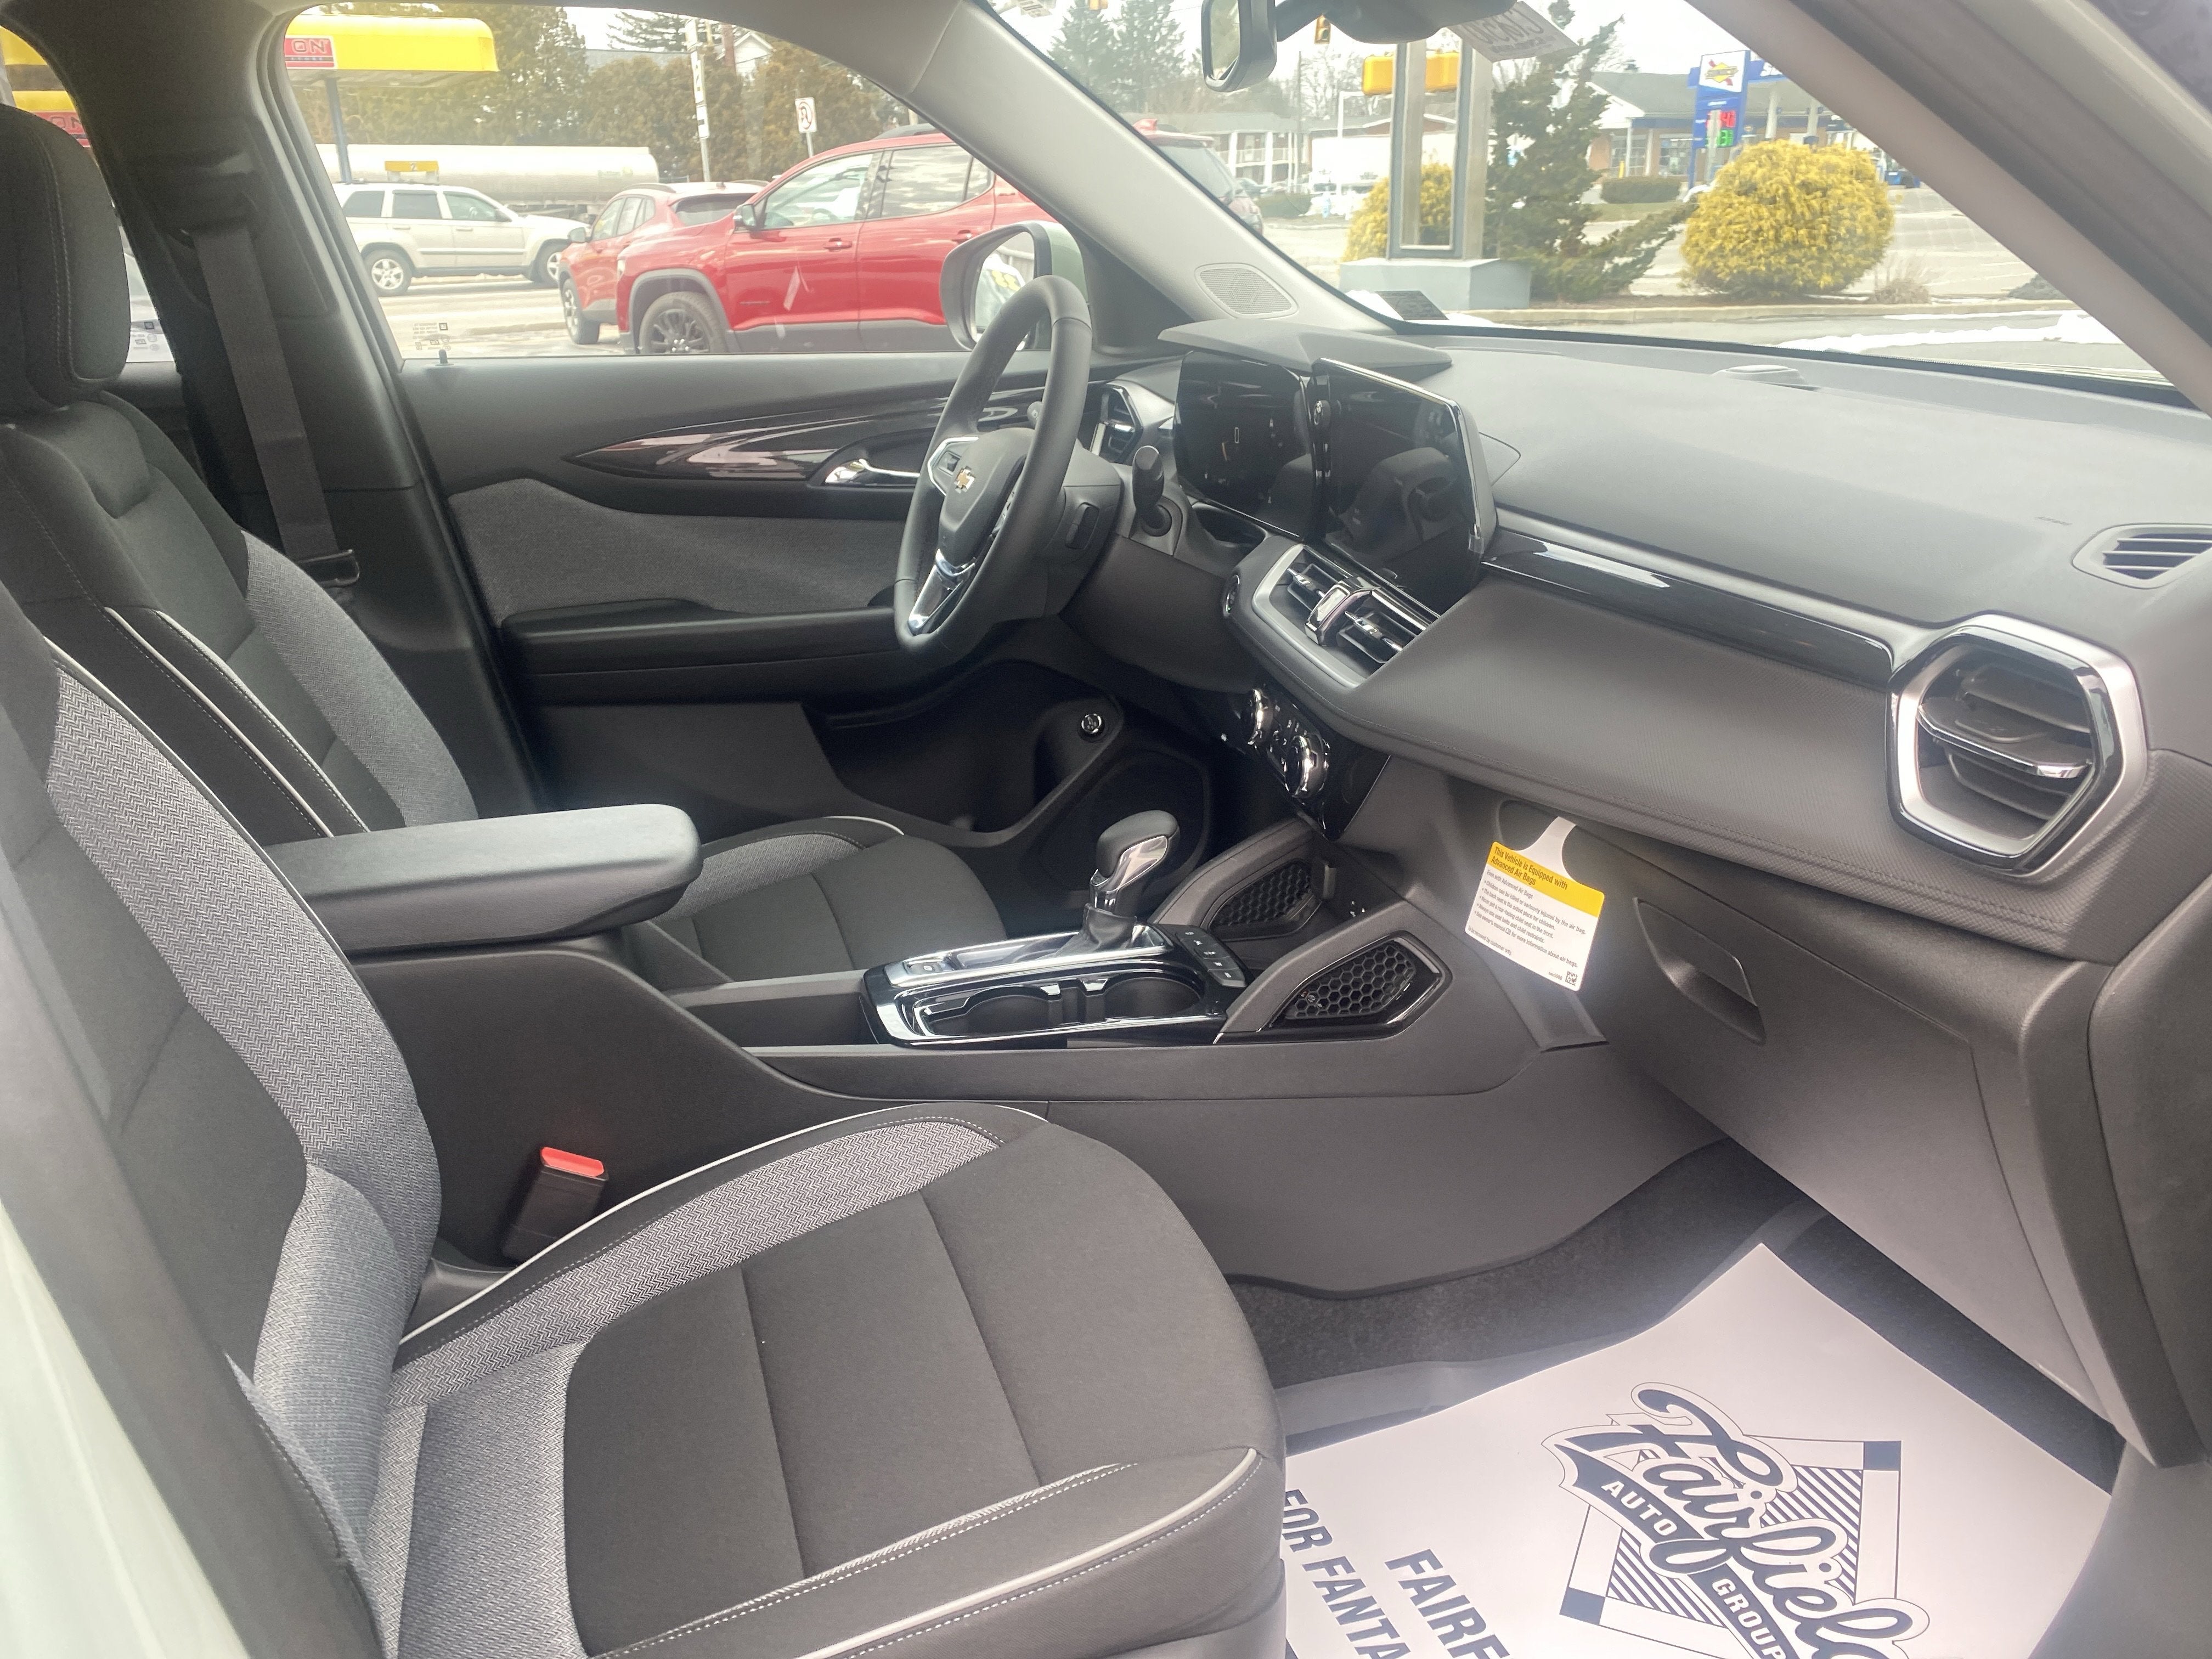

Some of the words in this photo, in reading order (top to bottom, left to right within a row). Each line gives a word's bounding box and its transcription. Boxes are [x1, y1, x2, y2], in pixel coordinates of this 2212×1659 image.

[1491, 856, 1515, 873] Advanced
[1514, 868, 1522, 878] Air
[1522, 872, 1536, 885] Bags
[1495, 847, 1505, 857] This
[1505, 852, 1522, 867] Vehicle
[1523, 862, 1528, 870] is
[1528, 865, 1554, 883] Equipped
[1554, 879, 1567, 890] with
[1502, 878, 1519, 891] Advanced
[1523, 890, 1533, 899] Bags
[1541, 910, 1555, 920] injured
[1576, 926, 1585, 935] bag.
[1566, 958, 1577, 967] bags.
[1282, 1489, 1333, 1553] FOR
[1565, 1389, 1913, 1659] Fairfiel
[1601, 1481, 1678, 1536] AUTO
[1384, 1548, 1510, 1659] FAIRF
[1712, 1578, 1787, 1659] GROUP
